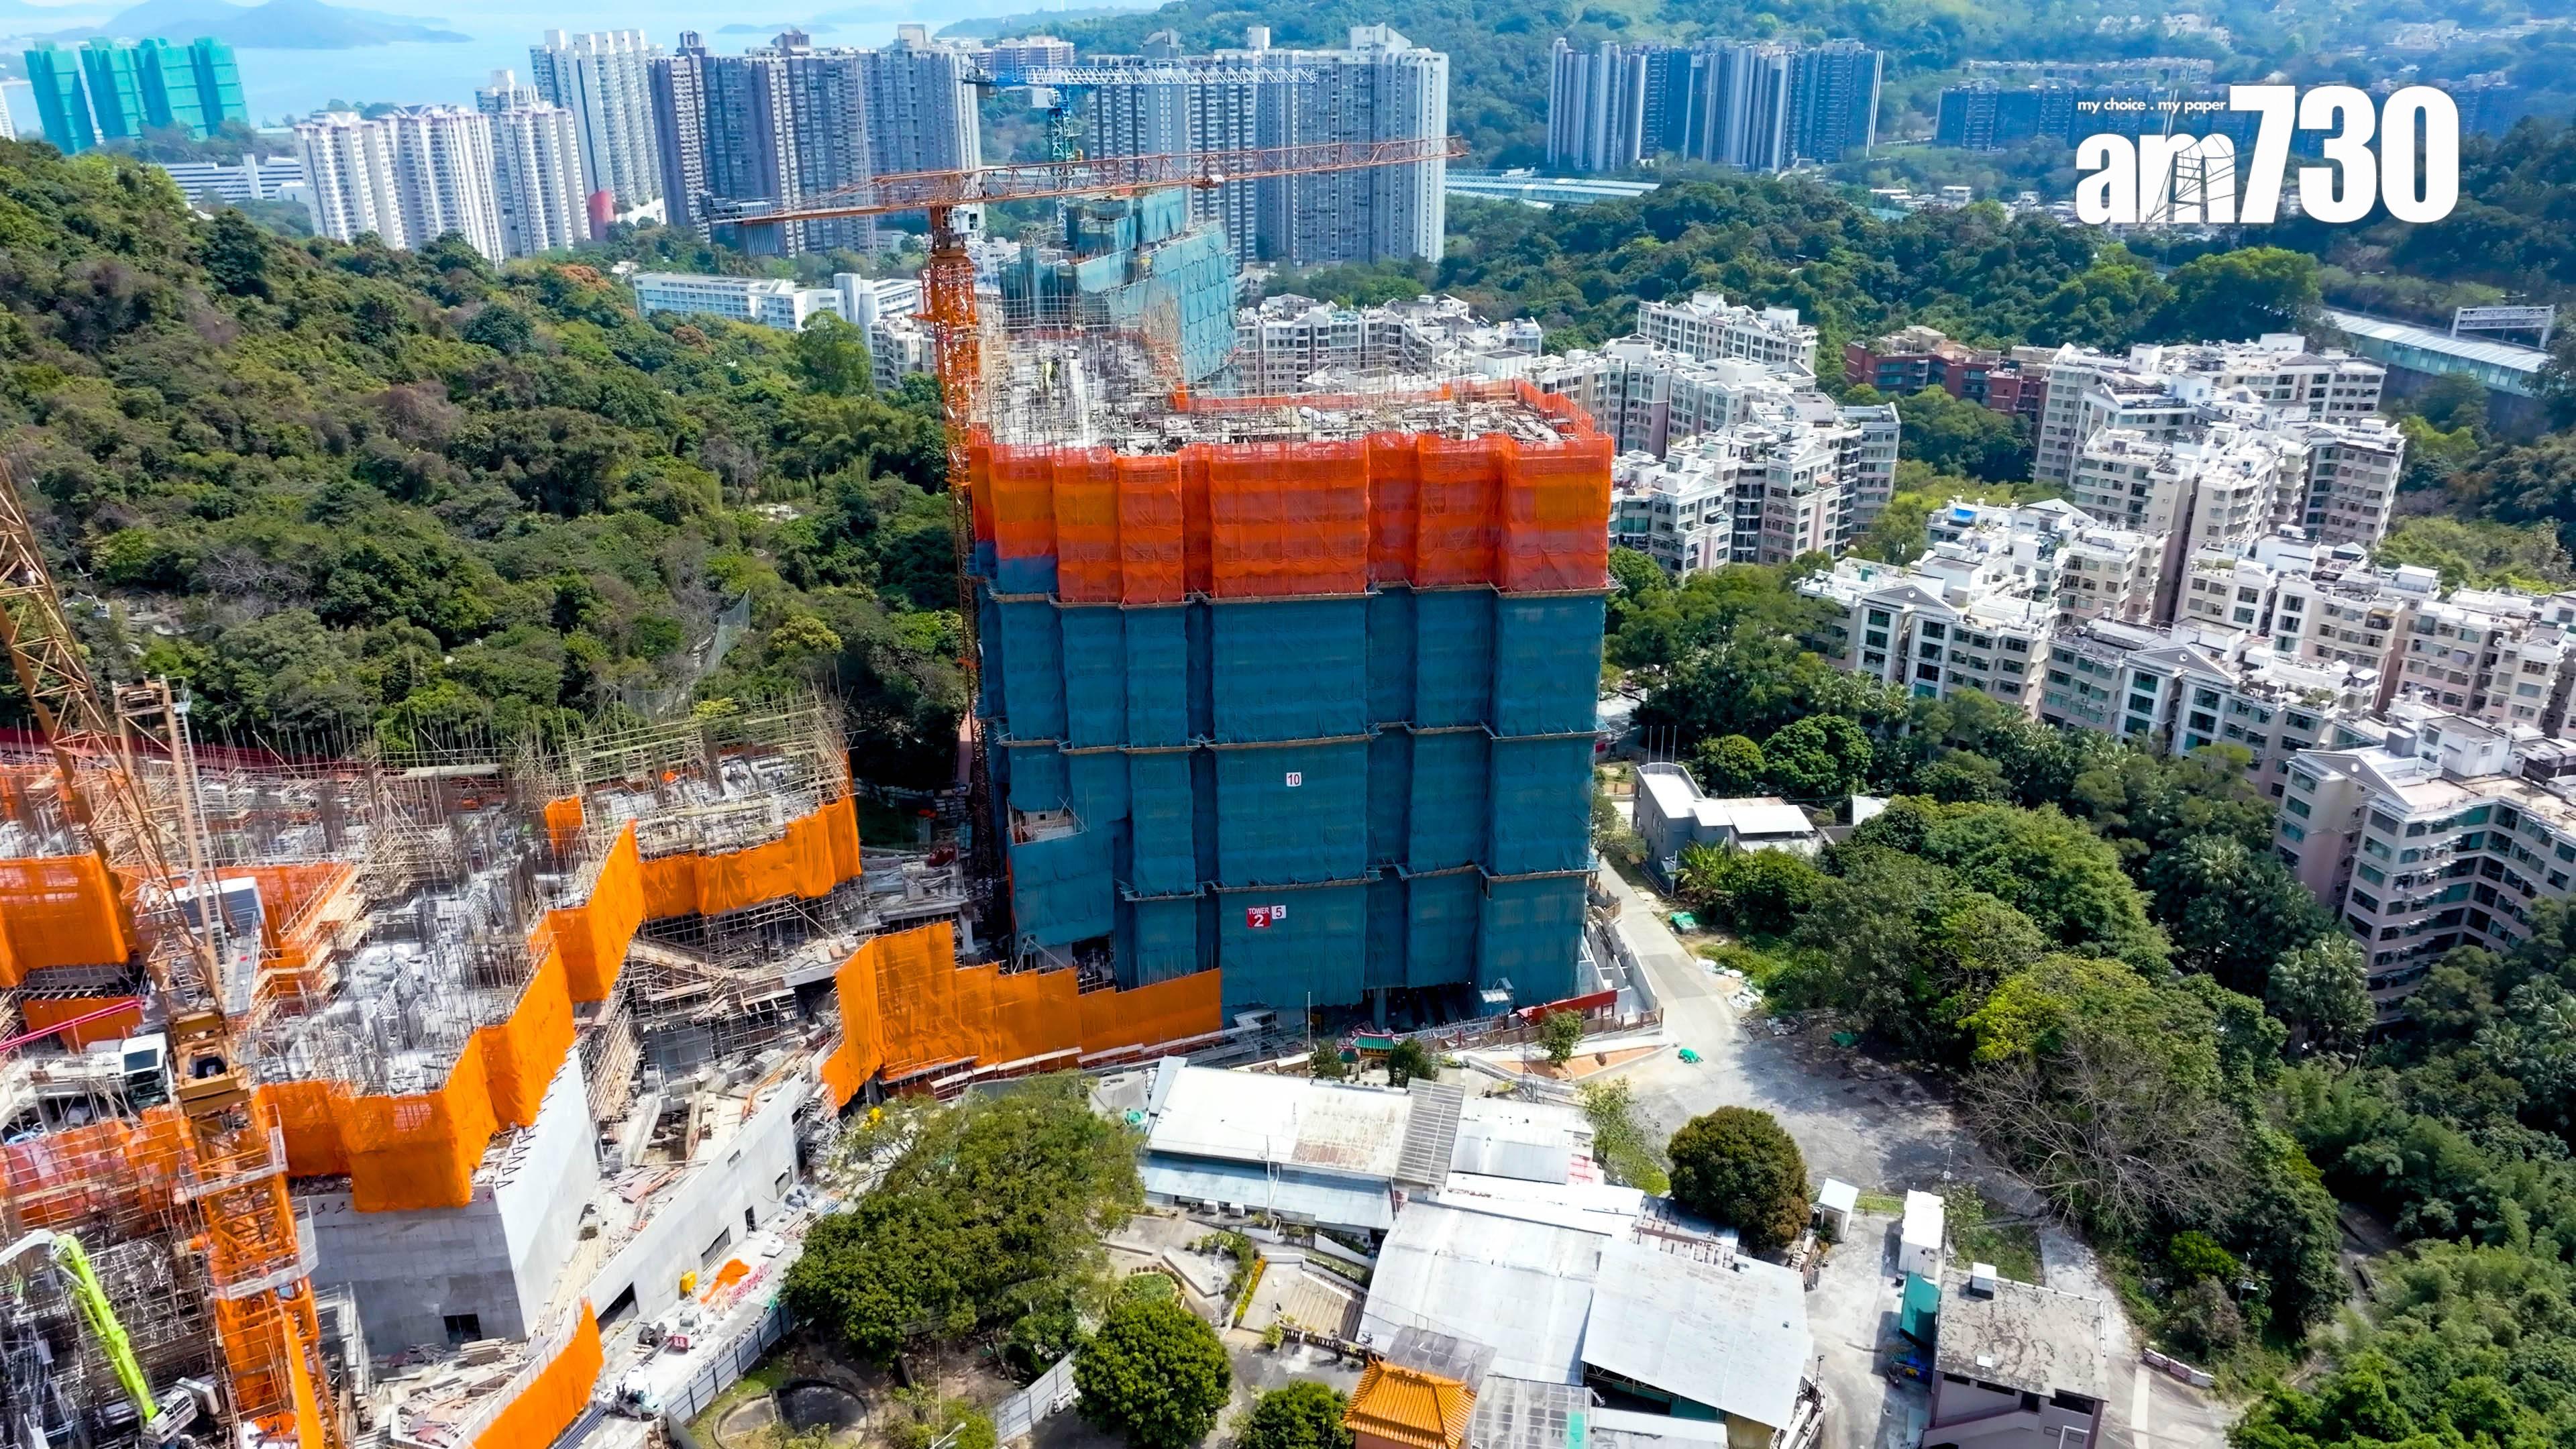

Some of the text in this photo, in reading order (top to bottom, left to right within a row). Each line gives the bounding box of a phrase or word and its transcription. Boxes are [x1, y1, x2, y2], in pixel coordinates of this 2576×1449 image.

[1288, 773, 1299, 785] 10
[1276, 907, 1282, 917] 5
[1254, 914, 1264, 927] 2
